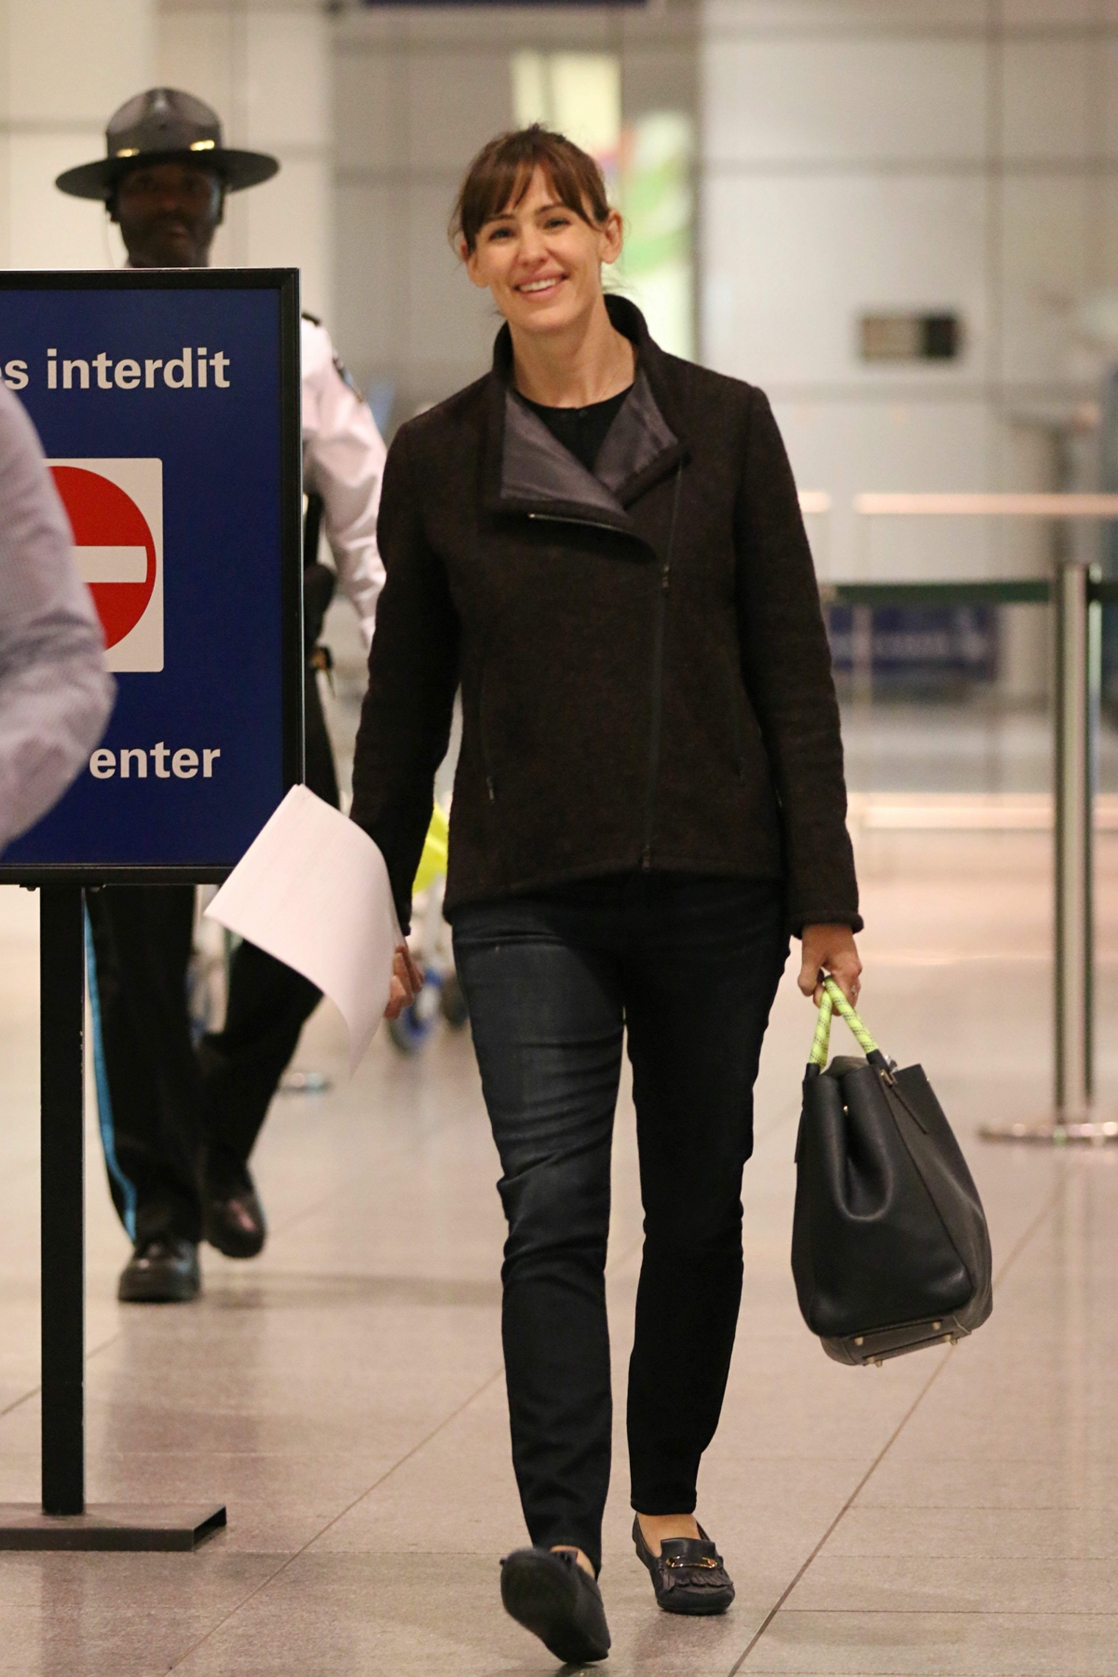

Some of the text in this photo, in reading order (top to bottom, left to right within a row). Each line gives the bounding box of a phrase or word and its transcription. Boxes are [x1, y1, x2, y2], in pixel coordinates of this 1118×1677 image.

[0, 347, 230, 390] s interdit
[89, 741, 221, 779] enter
